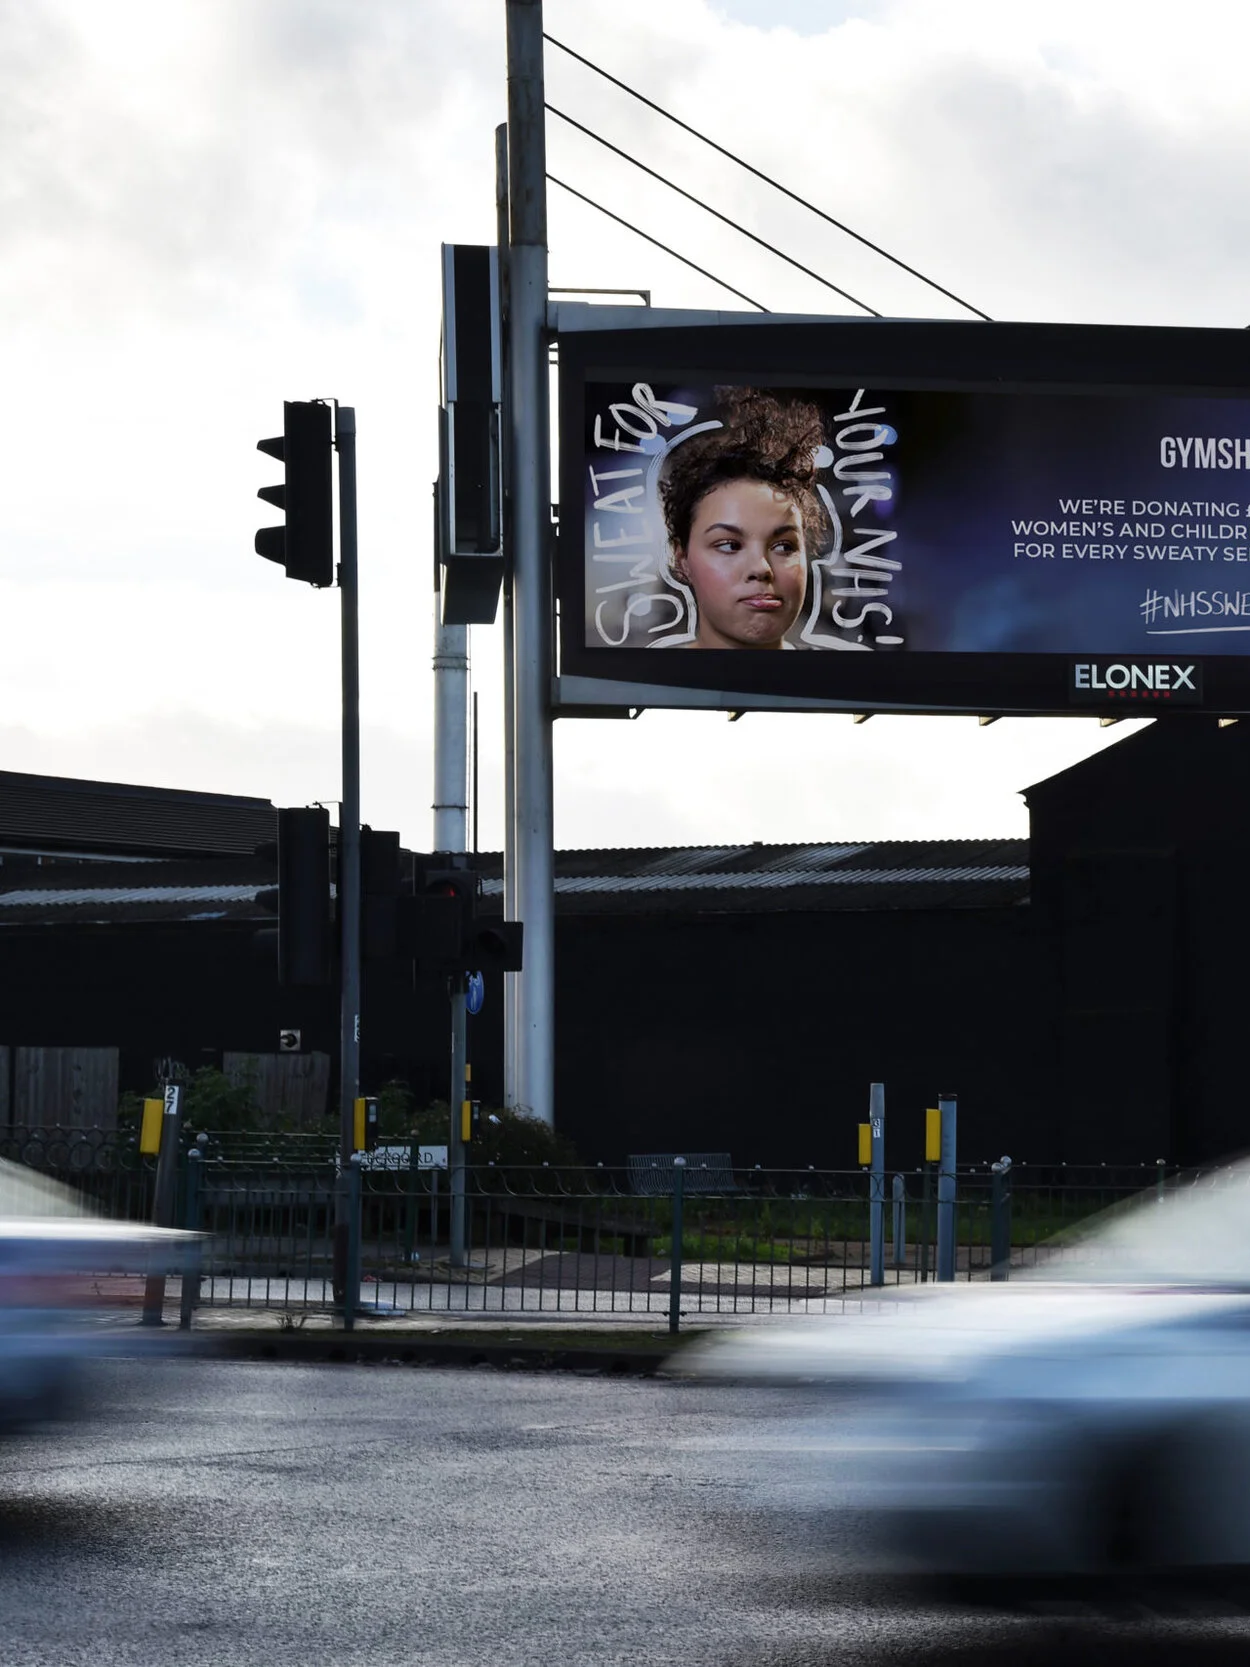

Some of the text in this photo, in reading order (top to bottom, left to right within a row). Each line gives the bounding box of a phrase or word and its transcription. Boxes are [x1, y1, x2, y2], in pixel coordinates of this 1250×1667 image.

[594, 382, 698, 453] FOR
[833, 388, 893, 518] YOUR
[1011, 520, 1114, 537] WOMEN'S
[1119, 522, 1166, 538] AND
[1058, 498, 1126, 515] WE'RE
[1132, 500, 1240, 517] DONATING
[589, 465, 684, 645] SWEAT
[1014, 542, 1055, 558] FOR
[1062, 543, 1129, 560] EVERY
[1133, 545, 1219, 561] SWEATY
[830, 528, 904, 645] NHS!
[1075, 664, 1196, 690] ELONEX
